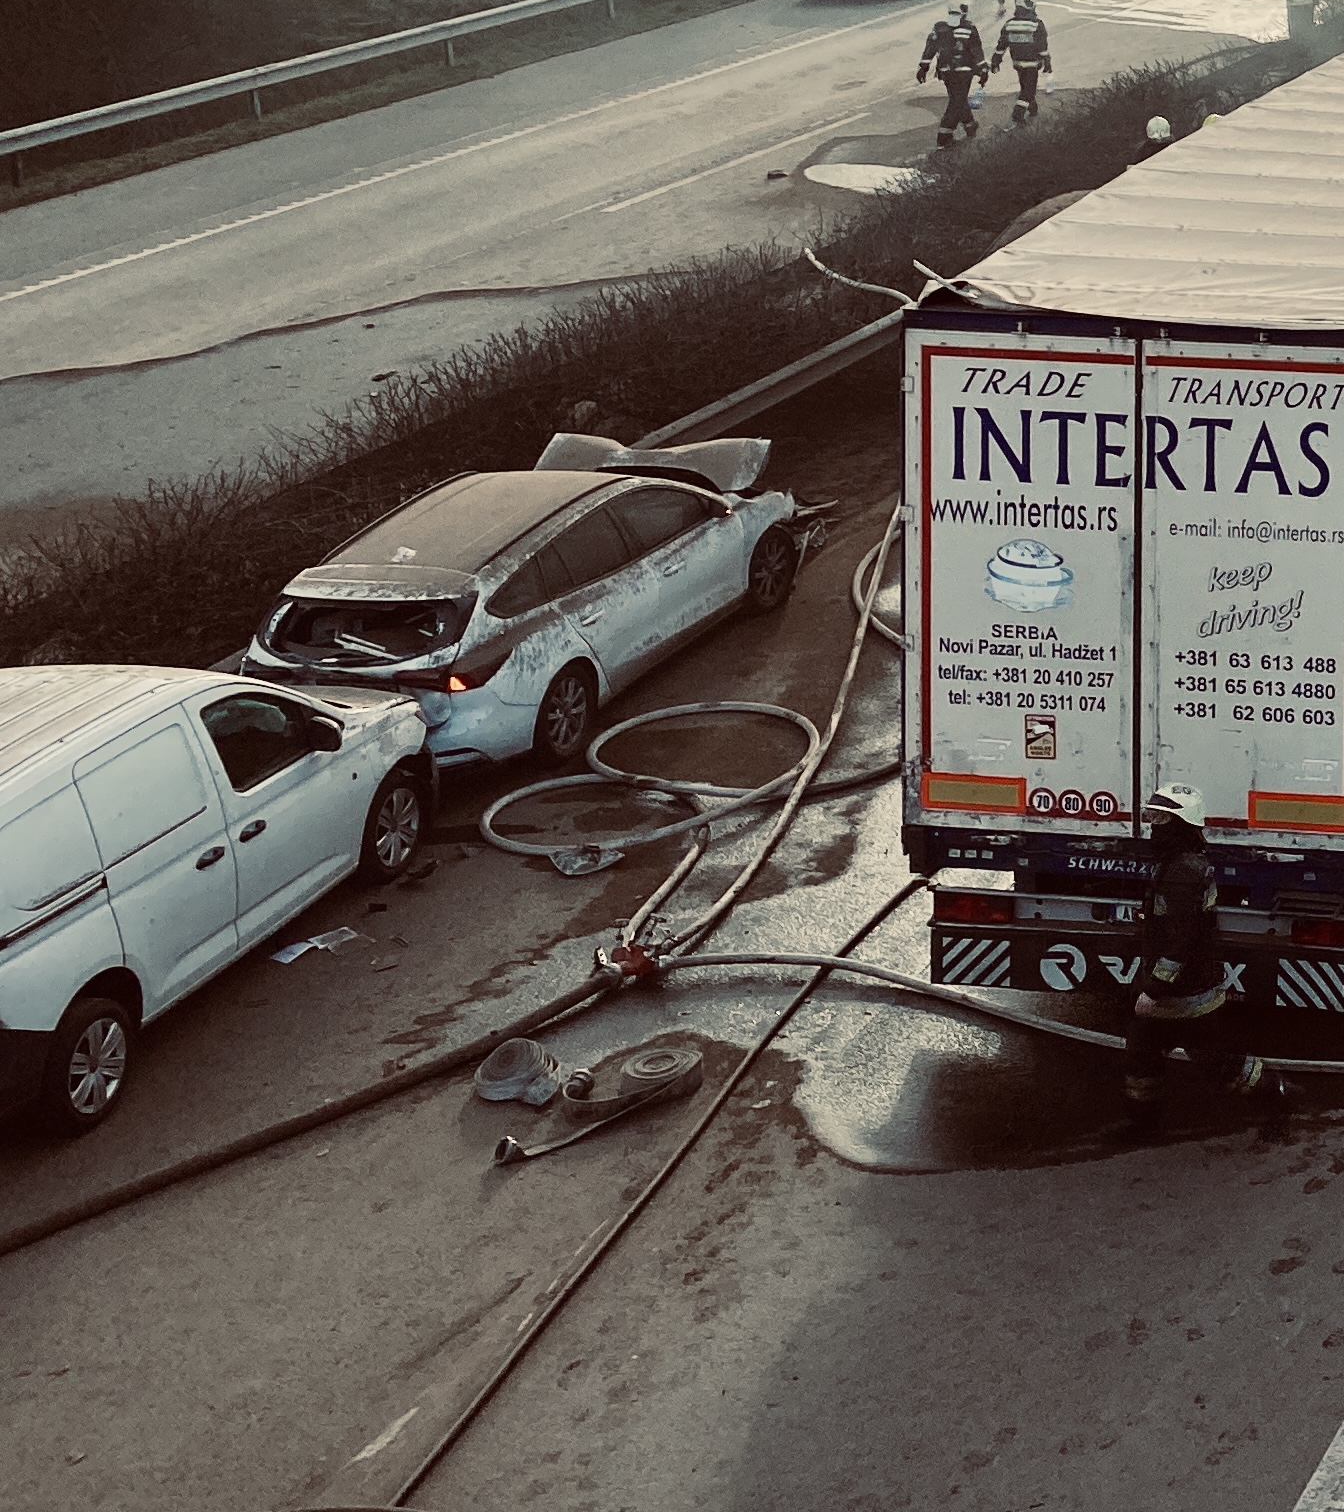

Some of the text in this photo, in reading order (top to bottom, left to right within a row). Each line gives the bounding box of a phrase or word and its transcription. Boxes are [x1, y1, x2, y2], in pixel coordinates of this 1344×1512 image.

[961, 367, 1092, 398] TRADE
[952, 406, 1330, 498] INTERTAS
[931, 489, 1118, 531] www.intertas.rs
[1169, 518, 1344, 544] e-mail: info@intertas.rs
[1208, 562, 1273, 593] keep
[1196, 589, 1304, 638] driving!
[939, 637, 1117, 661] Novi Pazar, ul. Hadžet 1
[1175, 650, 1336, 674] +381 63 613 488
[938, 664, 1114, 688] tel/fax: +381 20 410 257
[1174, 676, 1336, 700] +381 65 613 4880
[948, 689, 1106, 712] tel: +381 20 5311 074
[1173, 702, 1335, 726] +381 62 606 603
[1036, 795, 1050, 809] 70
[1064, 797, 1080, 811] 80
[1096, 799, 1111, 813] 90
